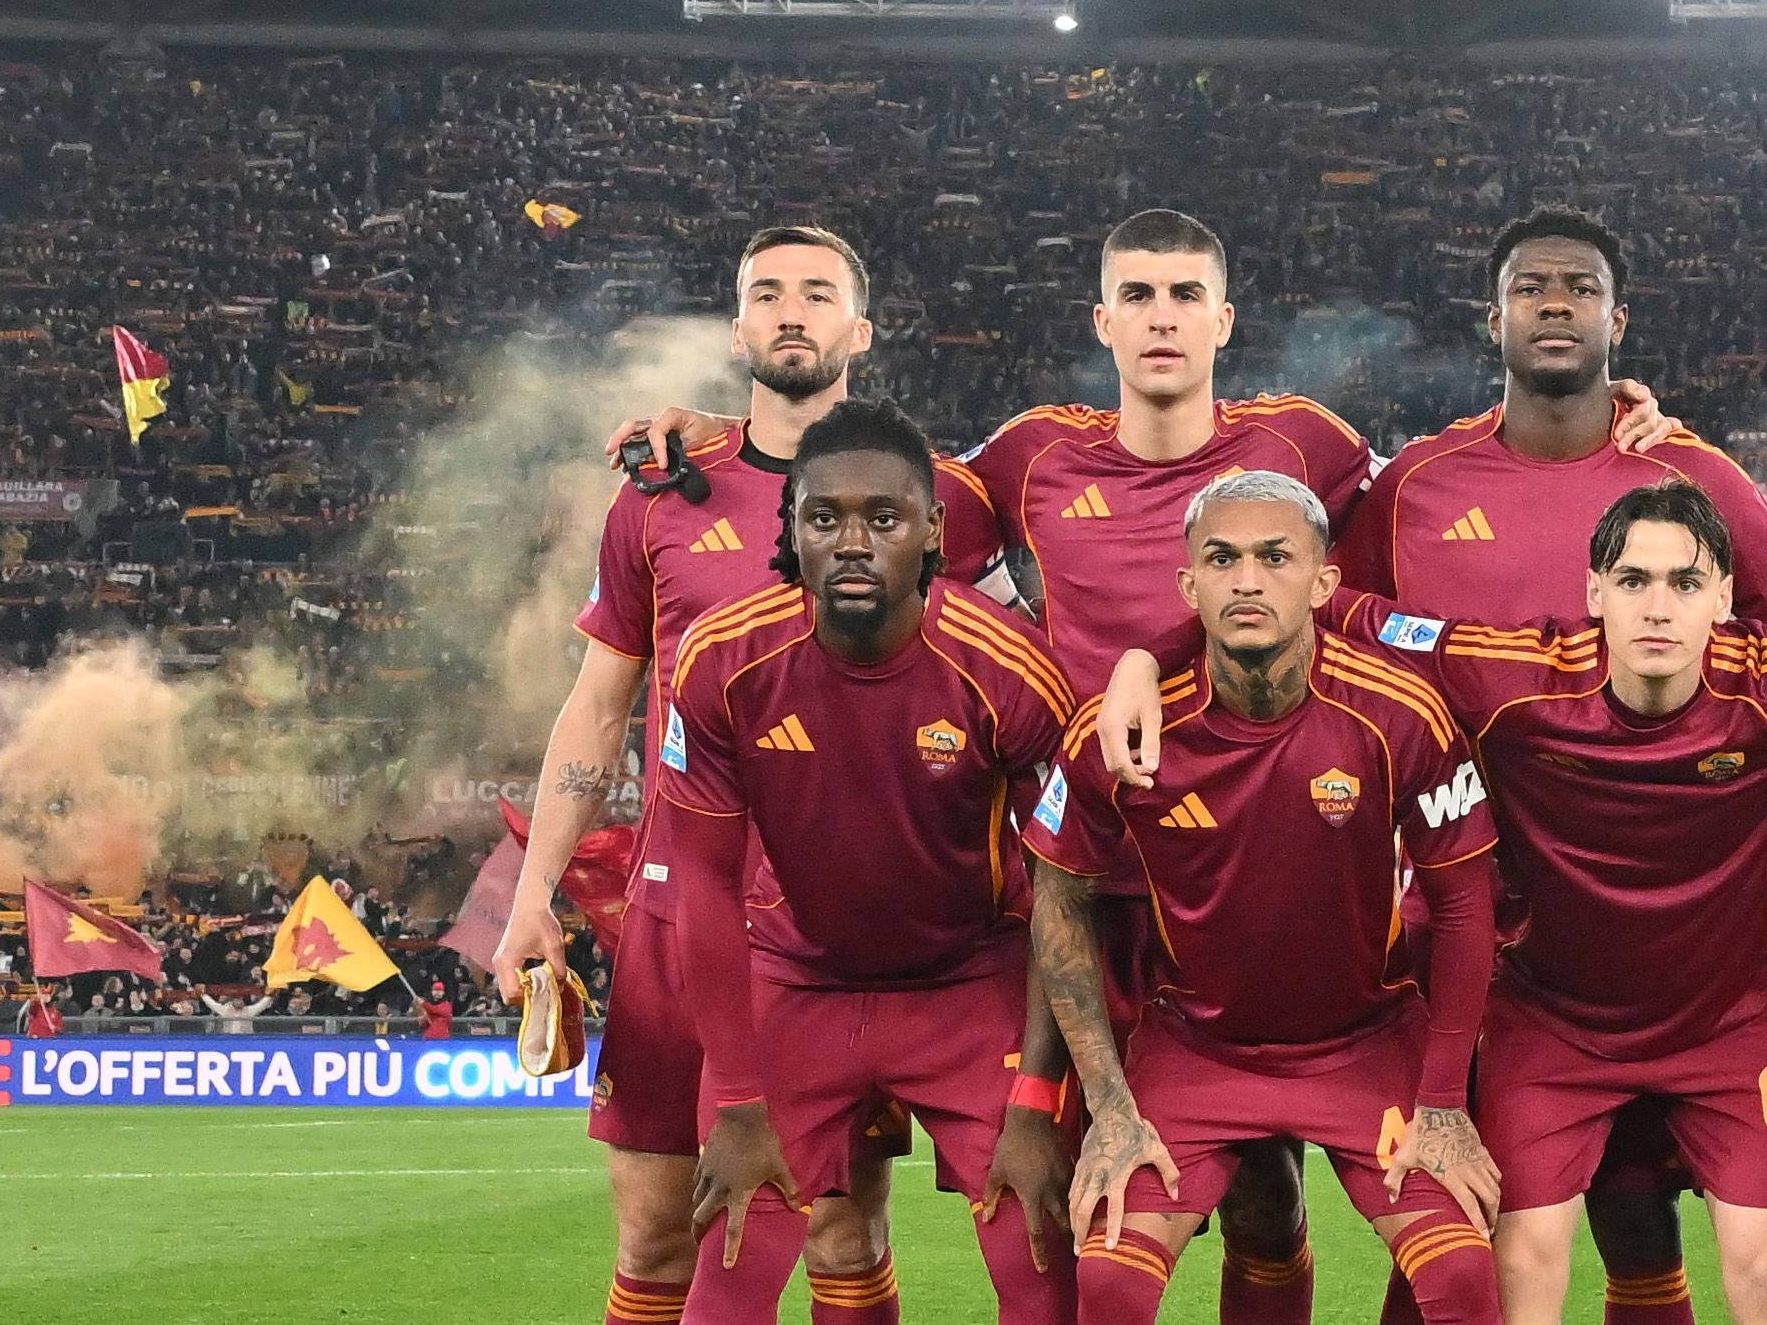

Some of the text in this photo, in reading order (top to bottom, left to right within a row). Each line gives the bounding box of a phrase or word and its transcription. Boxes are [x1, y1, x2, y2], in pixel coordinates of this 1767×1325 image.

[921, 750, 957, 763] ROMA
[1319, 801, 1355, 813] ROMA
[23, 1050, 302, 1096] L'OFFERTA
[314, 1039, 403, 1097] PIÙ
